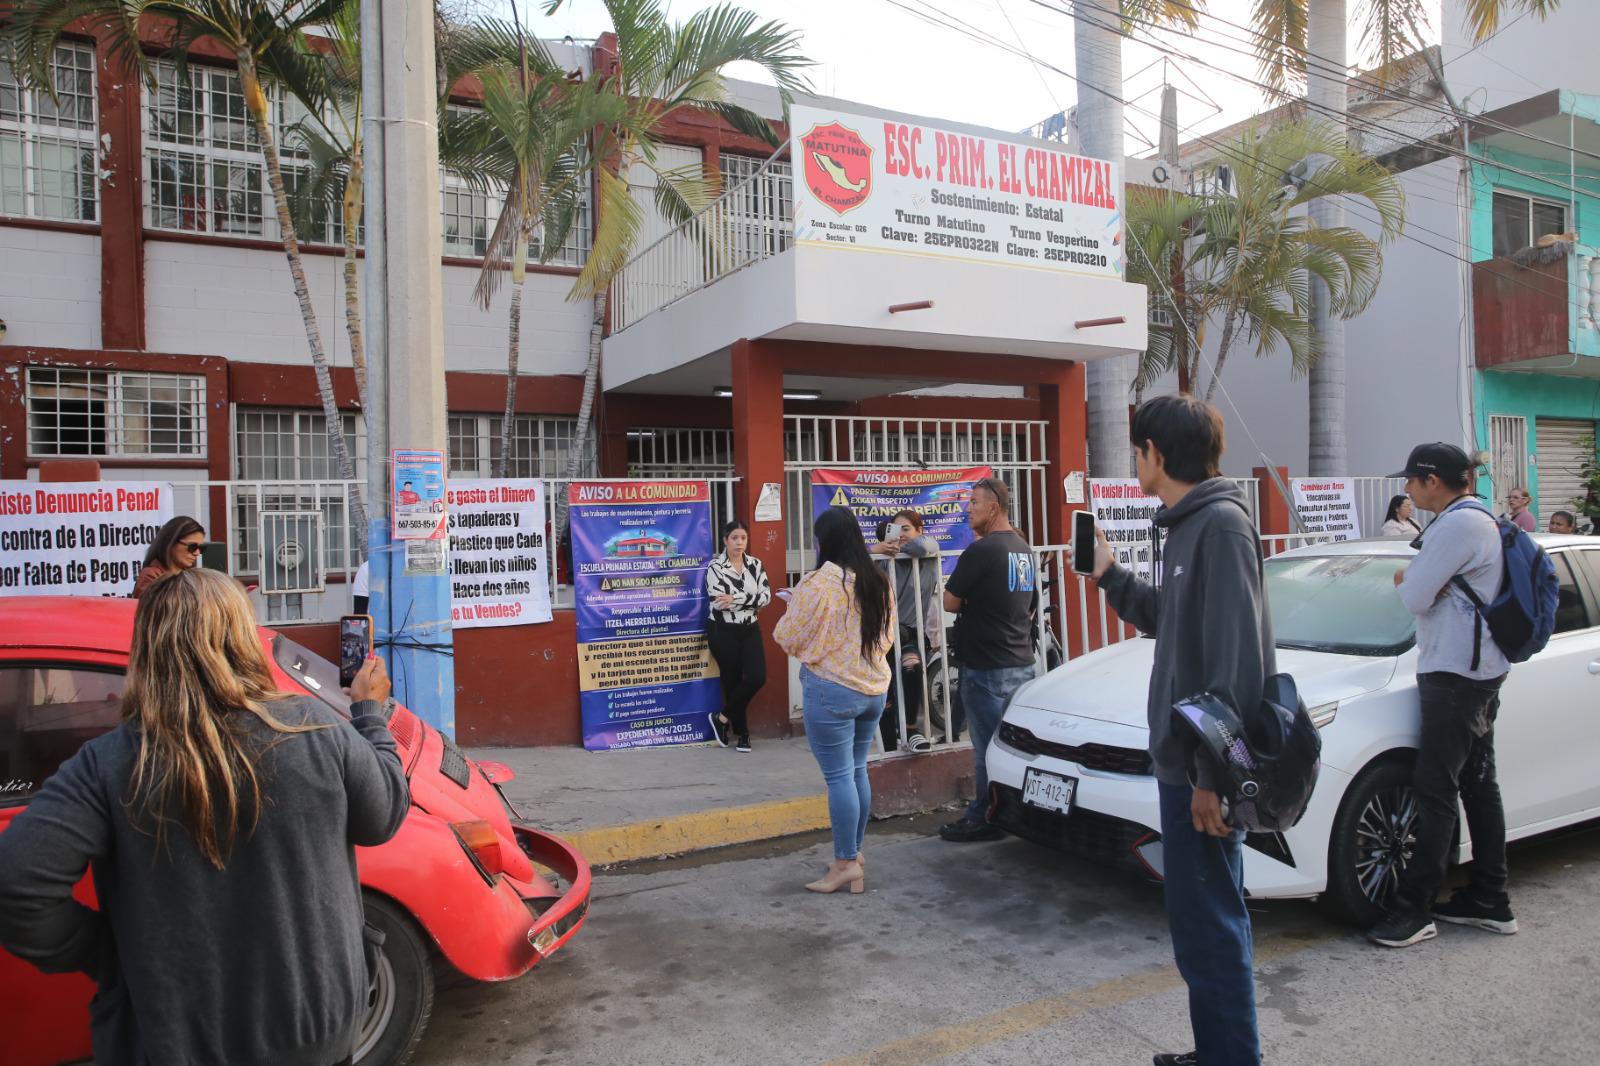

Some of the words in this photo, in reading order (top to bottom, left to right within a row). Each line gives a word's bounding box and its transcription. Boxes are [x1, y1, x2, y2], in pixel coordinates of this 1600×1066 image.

[806, 140, 868, 158] MATUTINA
[884, 122, 931, 180] ESC.
[935, 132, 994, 190] PRIM.
[998, 143, 1021, 194] EL
[1024, 148, 1115, 209] CHAMIZAL
[931, 188, 1019, 216] Sostenimiento:
[1025, 203, 1064, 223] Estatal
[811, 220, 826, 229] Zona
[829, 222, 853, 232] Escolar:
[855, 225, 867, 233] 026
[895, 209, 931, 225] Turno
[937, 215, 986, 233] Matutino
[826, 233, 847, 243] Sector:
[881, 226, 918, 243] Clave:
[924, 232, 999, 253] 25EPR0322N
[1010, 225, 1041, 241] Turno
[1046, 231, 1099, 249] Vespertino
[1007, 243, 1038, 258] Clave:
[855, 473, 889, 484] AVISO
[890, 475, 896, 483] A
[898, 475, 908, 483] LA
[910, 472, 963, 483] COMUNIDAD
[490, 487, 499, 503] el
[501, 486, 535, 502] Dinero
[579, 486, 613, 500] AVISO
[615, 487, 623, 500] A
[625, 486, 637, 499] LA
[640, 484, 697, 499] COMUNIDAD
[851, 487, 880, 495] PADRES
[893, 487, 921, 495] FAMILIA
[1102, 483, 1122, 498] existe
[35, 489, 113, 514] Denuncia
[117, 488, 160, 512] Penal
[457, 511, 511, 529] tapaderas
[513, 512, 519, 528] y
[1113, 507, 1125, 520] uso
[1329, 513, 1347, 521] Padres
[2, 528, 51, 552] contra
[56, 525, 76, 550] de
[80, 524, 96, 548] la
[450, 534, 492, 551] Plastico
[495, 536, 514, 551] que
[517, 532, 542, 549] Cada
[1126, 530, 1135, 542] ya
[1136, 528, 1147, 541] que
[1335, 534, 1347, 542] para
[24, 561, 62, 586] Falta
[66, 560, 86, 584] de
[91, 559, 128, 584] Pago
[454, 558, 487, 575] llevan
[490, 557, 506, 573] los
[508, 555, 537, 572] niños
[580, 563, 605, 573] ESCUELA
[605, 562, 633, 572] PRIMARIA
[633, 561, 655, 571] ESTATAL
[453, 581, 480, 598] Hace
[483, 580, 502, 597] dos
[504, 578, 530, 596] años
[612, 579, 621, 587] NO
[622, 578, 636, 587] HAN
[636, 577, 650, 586] SIDO
[651, 576, 680, 586] PAGADOS
[462, 605, 474, 620] tu
[474, 601, 522, 619] Vendes?
[605, 620, 624, 628] ITZEL
[625, 616, 656, 626] HERRERA
[657, 614, 679, 624] LEMUS
[616, 628, 640, 636] Directora
[588, 643, 627, 651] Directora
[628, 642, 643, 650] que
[639, 647, 675, 656] recursos
[601, 661, 612, 669] de
[625, 657, 658, 666] escuela
[671, 653, 700, 663] nuestra
[591, 672, 596, 680] y
[597, 670, 606, 678] la
[607, 667, 635, 678] tarjeta
[637, 667, 652, 675] que
[680, 661, 708, 670] maneja
[599, 680, 618, 688] pero
[630, 721, 644, 729] CASO
[654, 718, 673, 726] JUICIO:
[617, 730, 654, 740] EXPEDIENTE
[655, 724, 692, 736] 906/2025
[674, 733, 703, 742] MAZATLÁN
